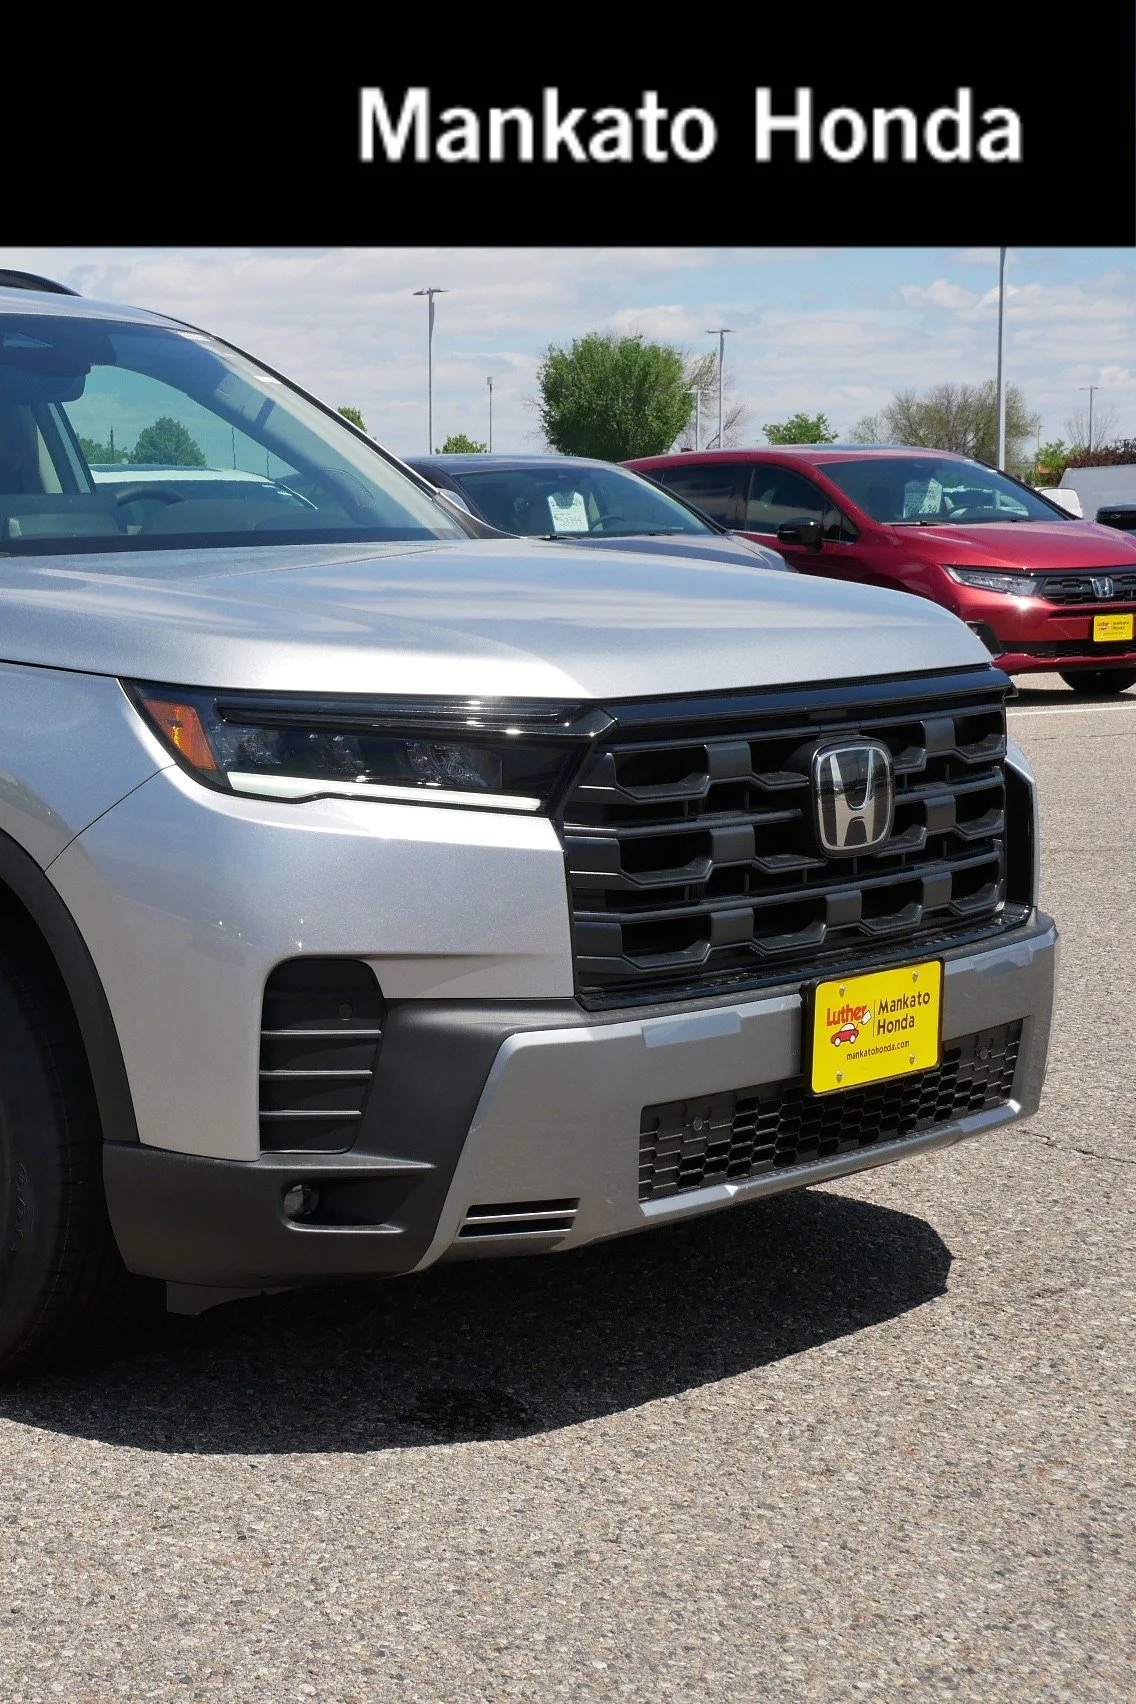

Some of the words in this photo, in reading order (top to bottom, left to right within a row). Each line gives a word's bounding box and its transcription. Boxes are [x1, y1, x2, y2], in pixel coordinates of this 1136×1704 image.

[877, 991, 931, 1015] Mankato
[826, 1003, 868, 1027] Luther
[877, 1013, 915, 1036] Honda
[846, 1040, 910, 1061] mankatohonda.com
